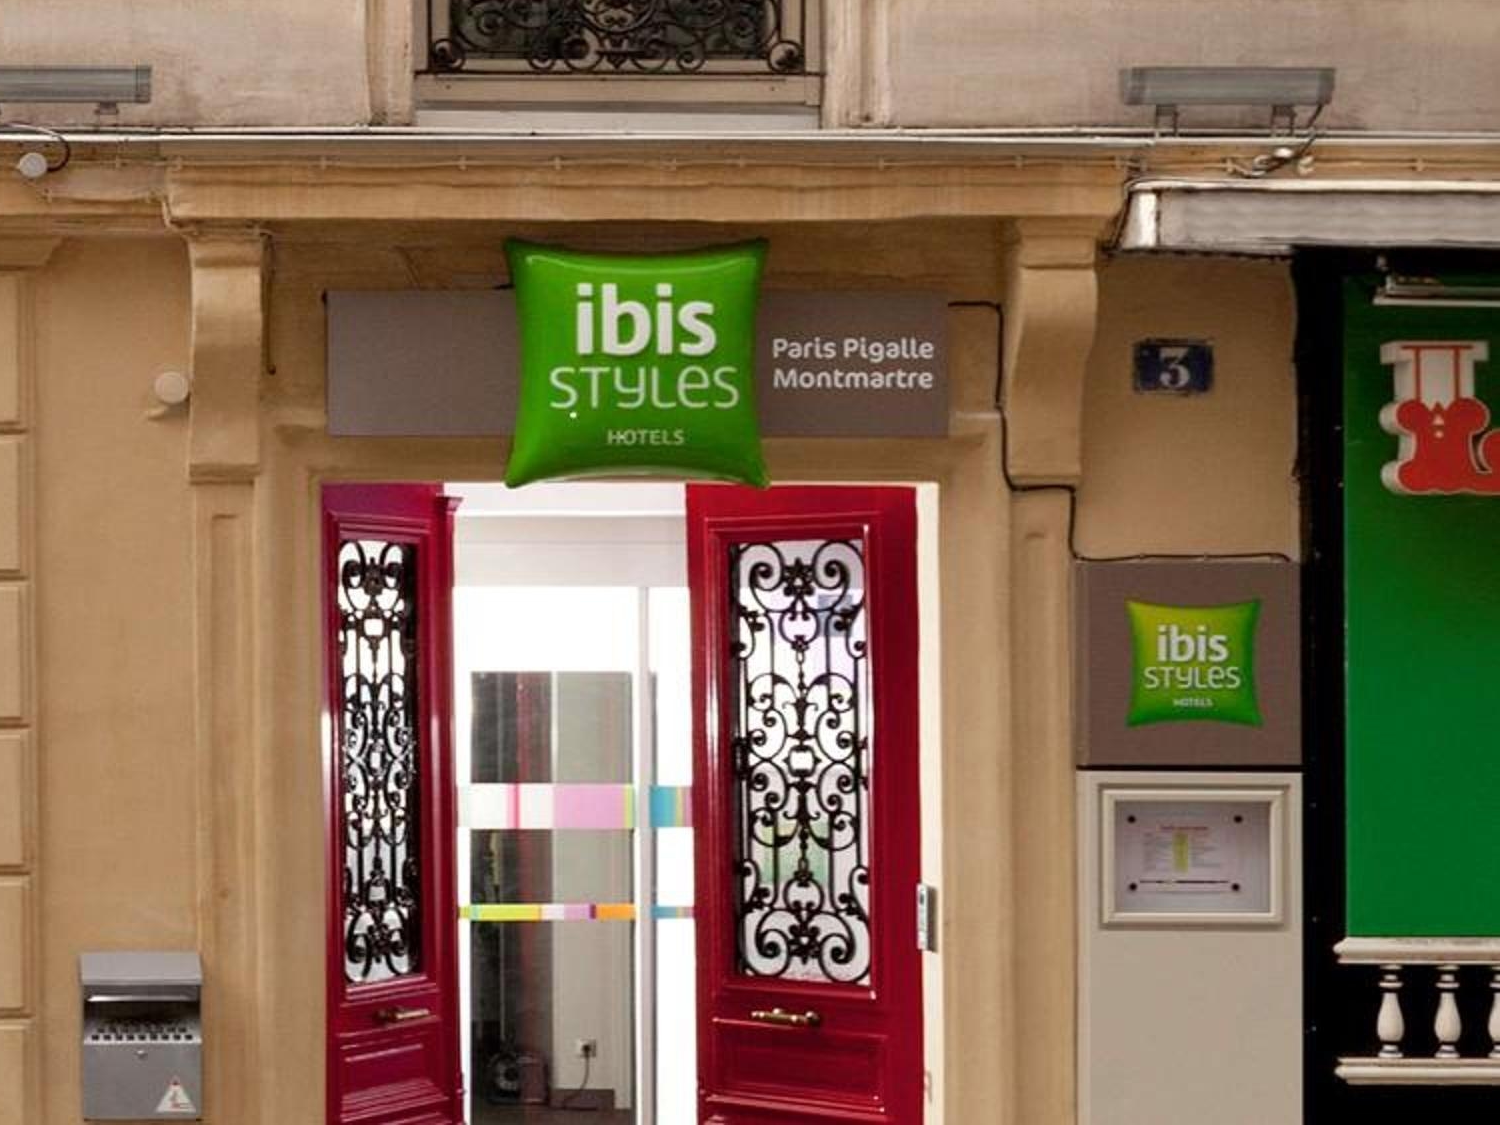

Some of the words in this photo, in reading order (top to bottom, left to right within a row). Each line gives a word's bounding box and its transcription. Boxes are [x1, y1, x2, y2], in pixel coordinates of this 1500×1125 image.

[576, 282, 717, 356] ibis
[772, 336, 837, 359] Paris
[843, 336, 934, 363] Pigalle
[772, 368, 934, 389] Montmartre
[1159, 346, 1190, 388] 3
[607, 429, 685, 446] HOTELS
[1156, 624, 1229, 663] ibis
